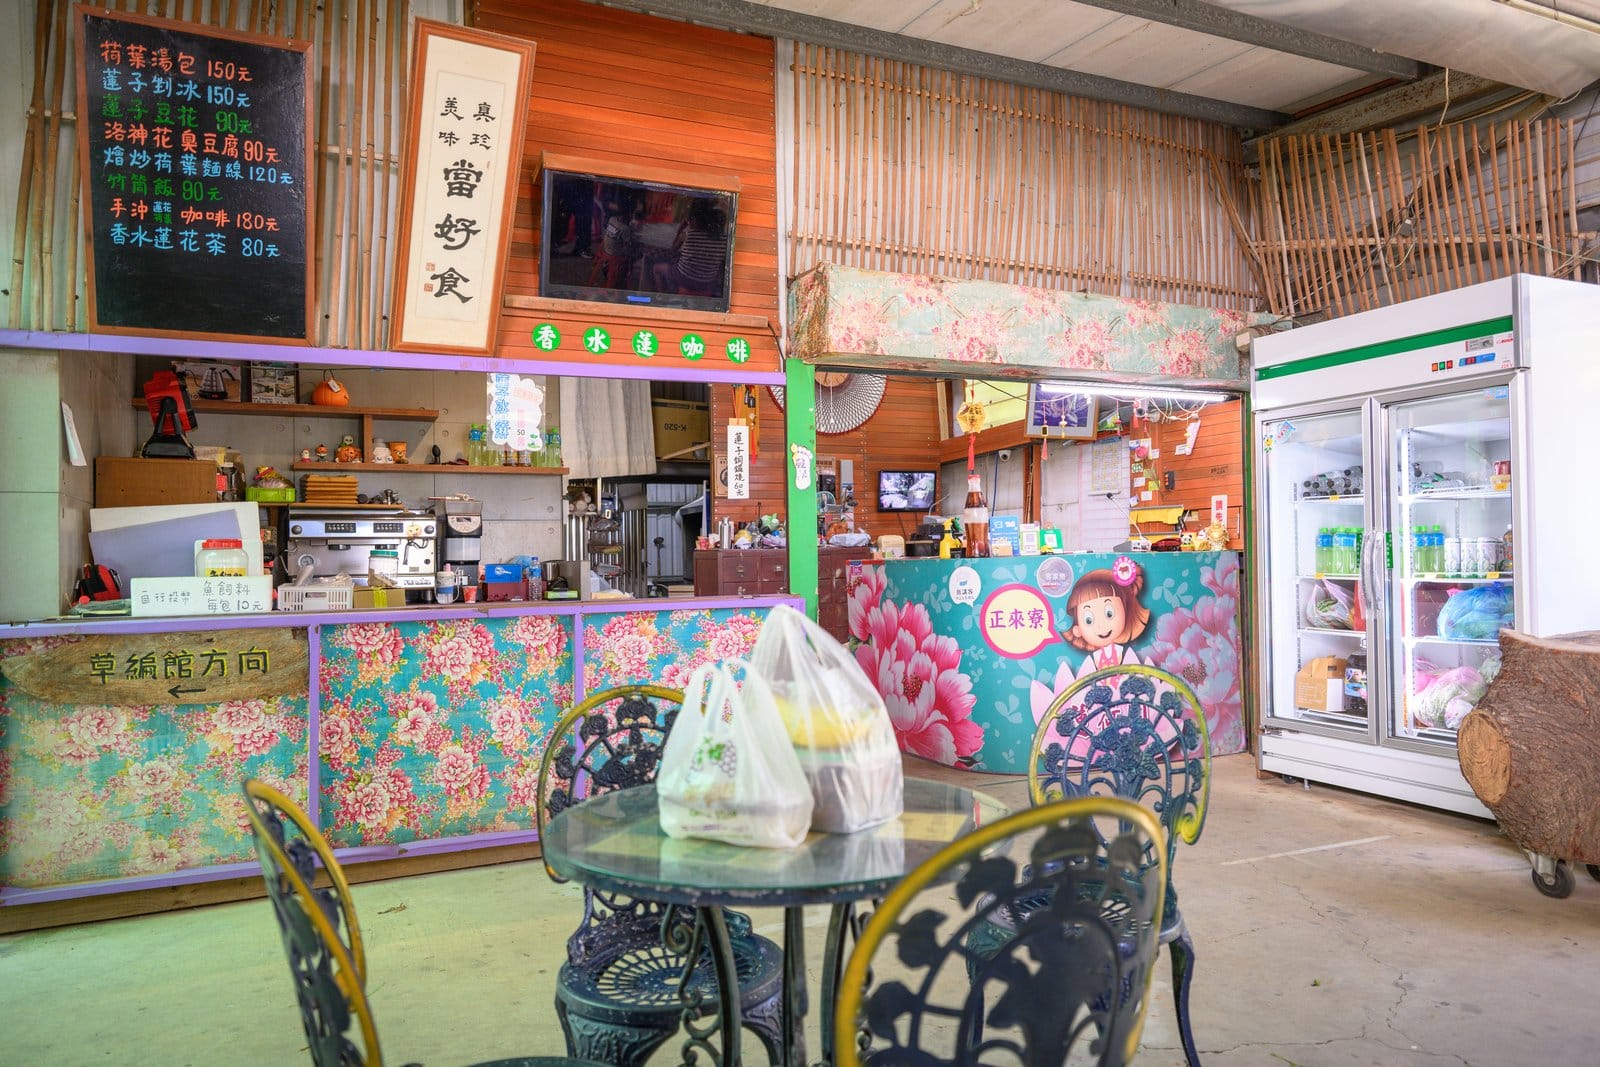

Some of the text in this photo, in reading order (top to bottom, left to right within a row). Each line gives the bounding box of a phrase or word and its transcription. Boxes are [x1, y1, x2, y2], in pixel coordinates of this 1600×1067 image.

[100, 40, 254, 82] 荷葉湯包 150元
[102, 94, 253, 134] 蓮子豆花 90元
[207, 87, 251, 108] 150元
[438, 97, 464, 146] 美味
[104, 121, 282, 163] 洛神花臭豆腐 90元
[107, 173, 223, 202] 竹筒飯 90元
[249, 167, 295, 185] 120元
[181, 206, 231, 228] 咖啡
[236, 212, 281, 232] 180元
[110, 223, 281, 258] 香水蓮花茶 80元
[535, 325, 748, 363] 香水蓮咖啡
[988, 608, 1045, 629] 正來寮
[89, 646, 271, 685] 草編館方向
